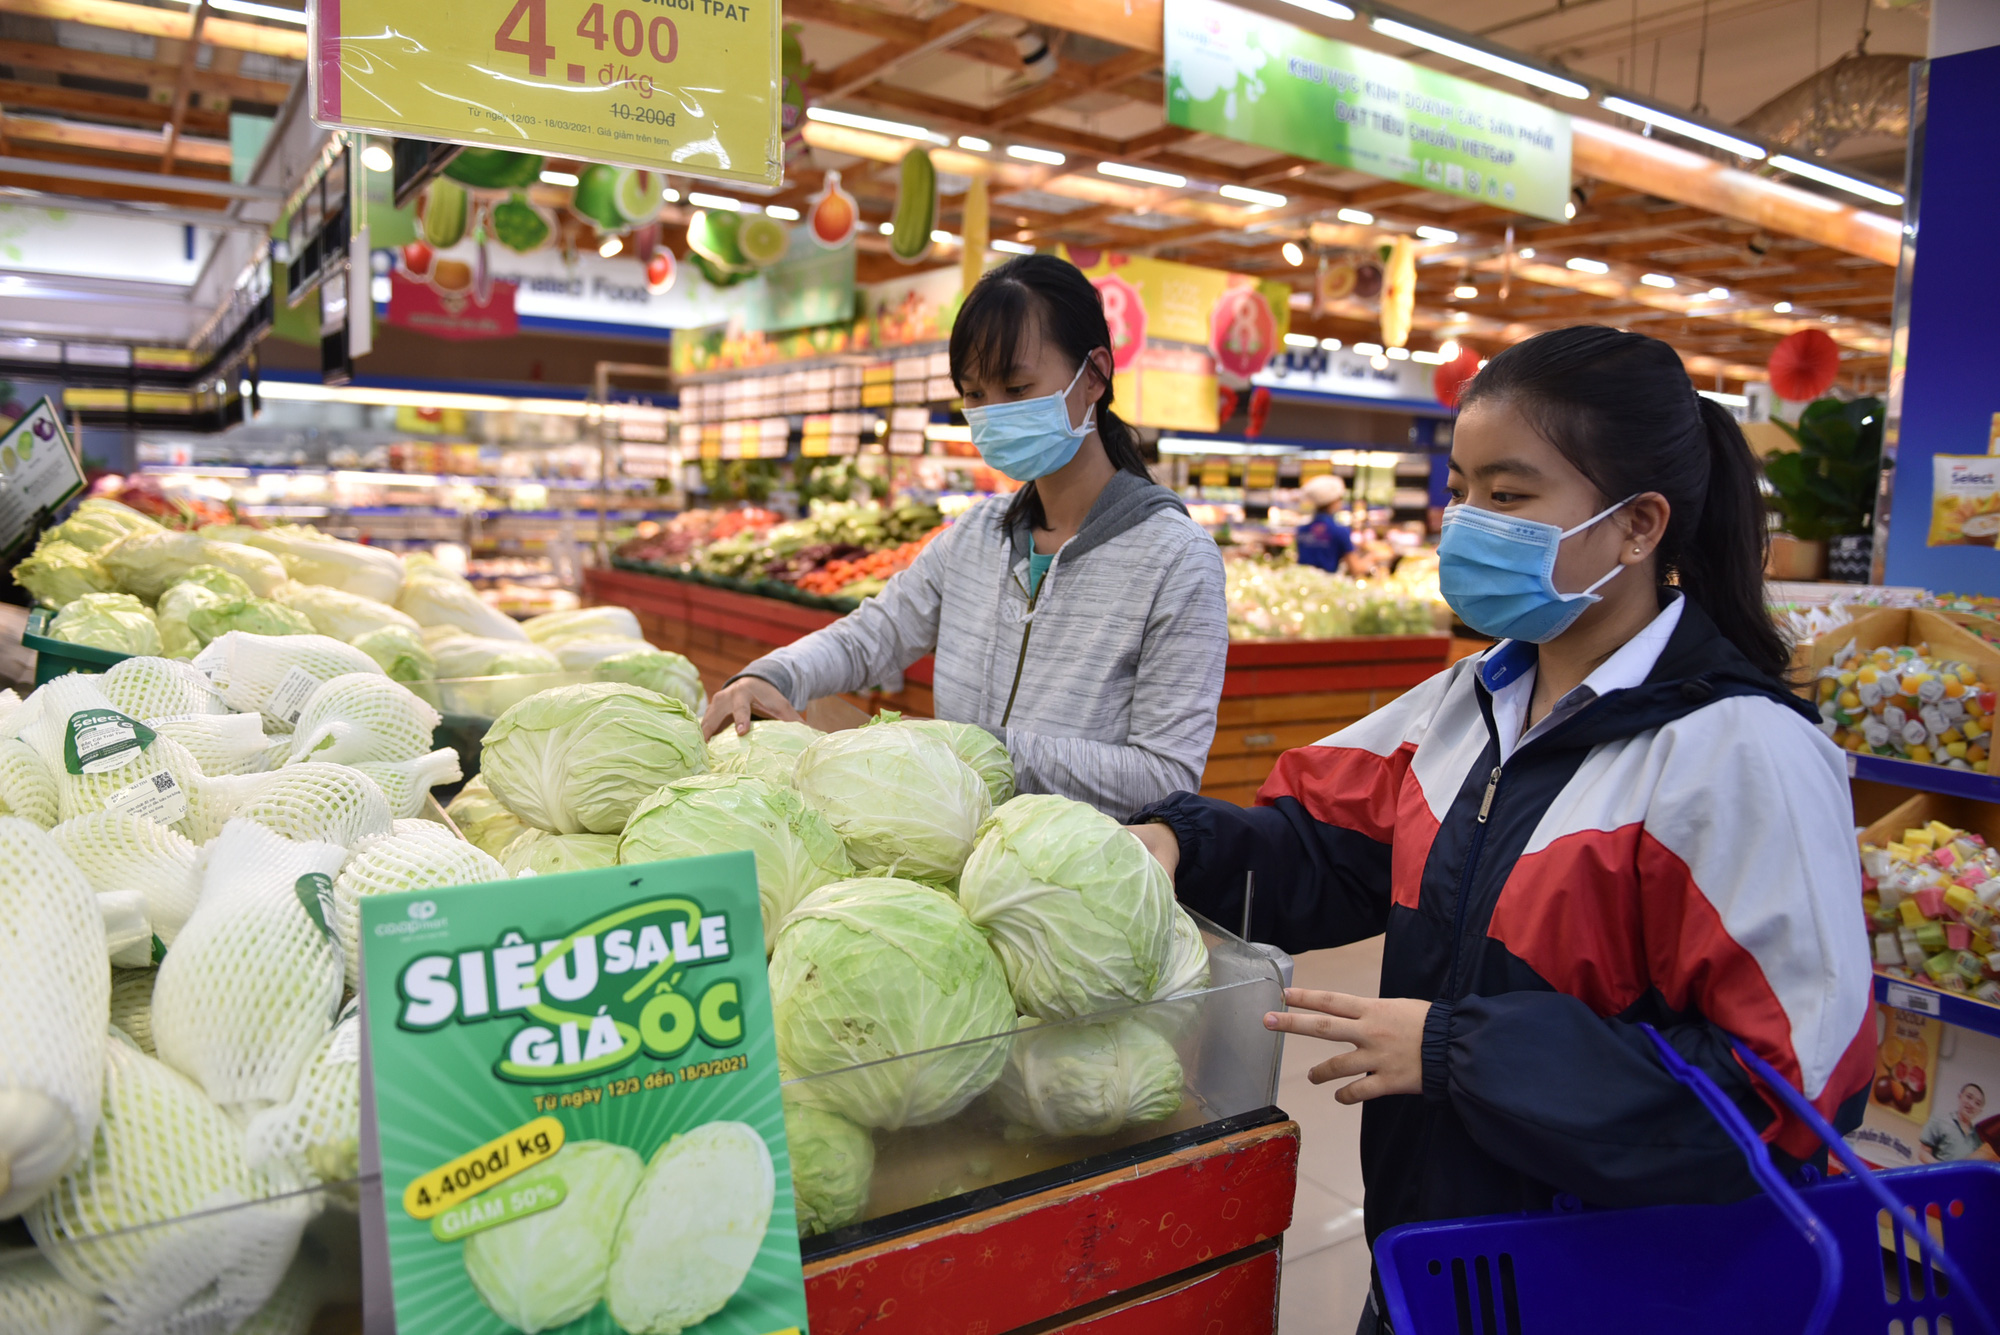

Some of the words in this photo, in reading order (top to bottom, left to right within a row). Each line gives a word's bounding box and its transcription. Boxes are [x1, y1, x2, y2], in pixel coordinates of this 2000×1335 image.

[703, 0, 750, 22] TPAT
[597, 63, 654, 99] đ/kg
[1288, 56, 1323, 84] KHU
[468, 106, 481, 117] Từ
[485, 111, 508, 123] ngày
[511, 114, 536, 125] 12/03
[597, 126, 612, 137] Giá
[613, 129, 635, 142] giảm
[636, 133, 652, 145] trên
[653, 136, 672, 147] tem.
[609, 102, 676, 127] 10.200đ
[73, 715, 124, 732] Select
[403, 932, 599, 1027] SIÊU
[603, 915, 729, 975] SALE
[510, 1004, 624, 1067] GIÁ
[560, 1086, 602, 1109] ngày
[607, 1076, 641, 1098] 12/3
[643, 1067, 675, 1090] đến
[678, 1054, 748, 1082] 18/3/2021
[516, 1131, 551, 1157] kg
[442, 1197, 505, 1233] GIẢM
[509, 1184, 558, 1212] 50%
